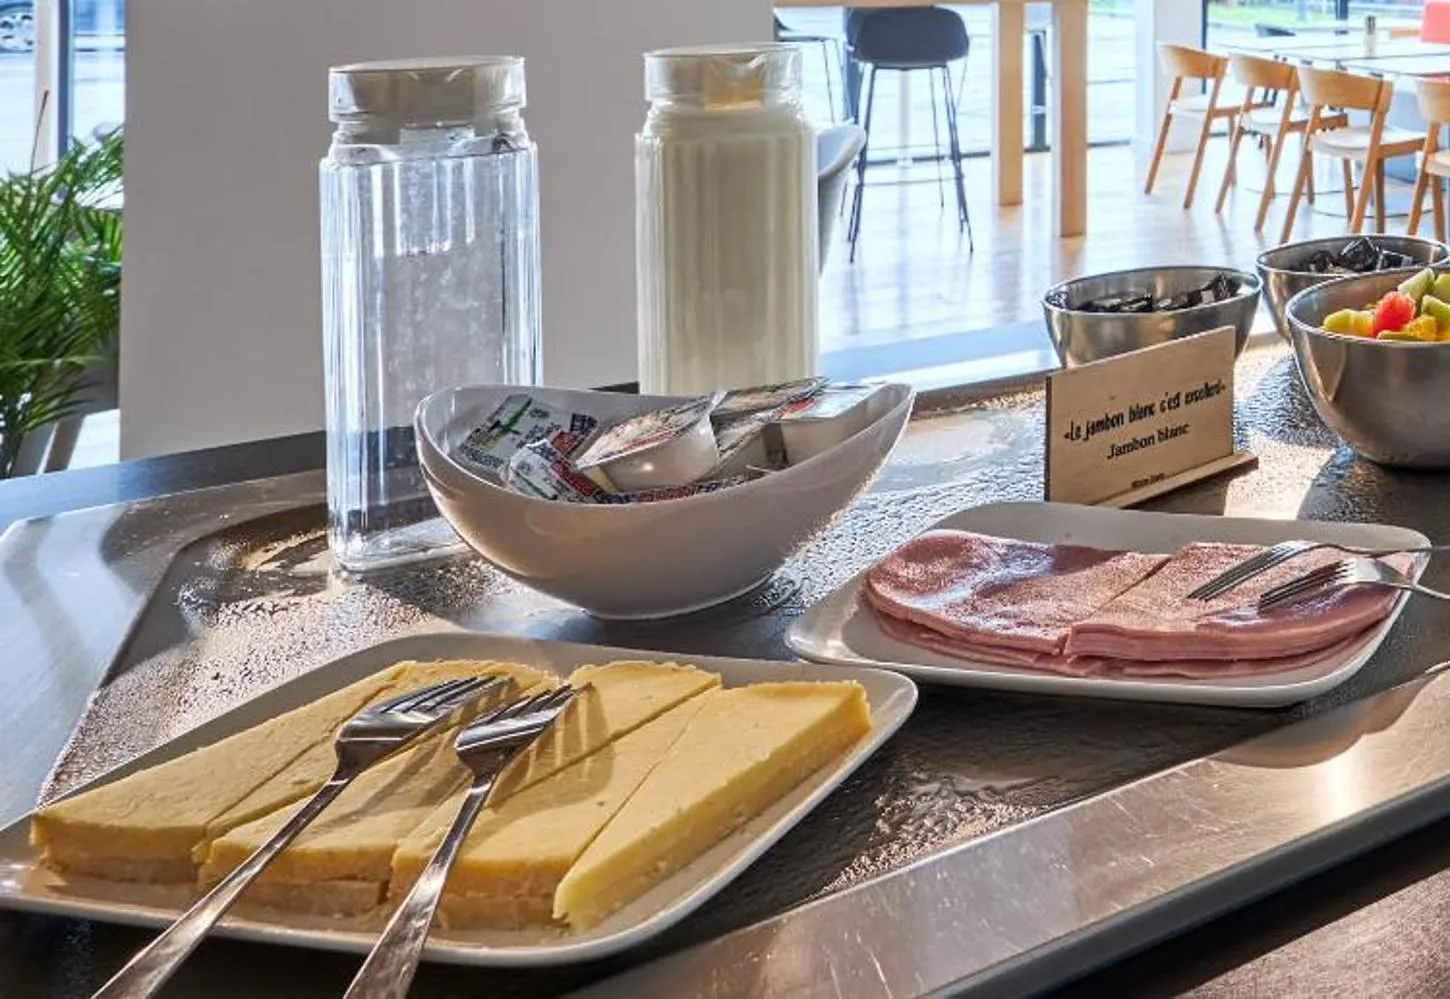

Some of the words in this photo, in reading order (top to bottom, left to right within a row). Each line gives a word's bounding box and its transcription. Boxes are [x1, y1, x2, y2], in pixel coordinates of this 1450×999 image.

[1083, 411, 1125, 442] jambon
[1128, 401, 1157, 424] blanc
[1107, 433, 1156, 461] Jambon
[1157, 422, 1191, 443] blanc
